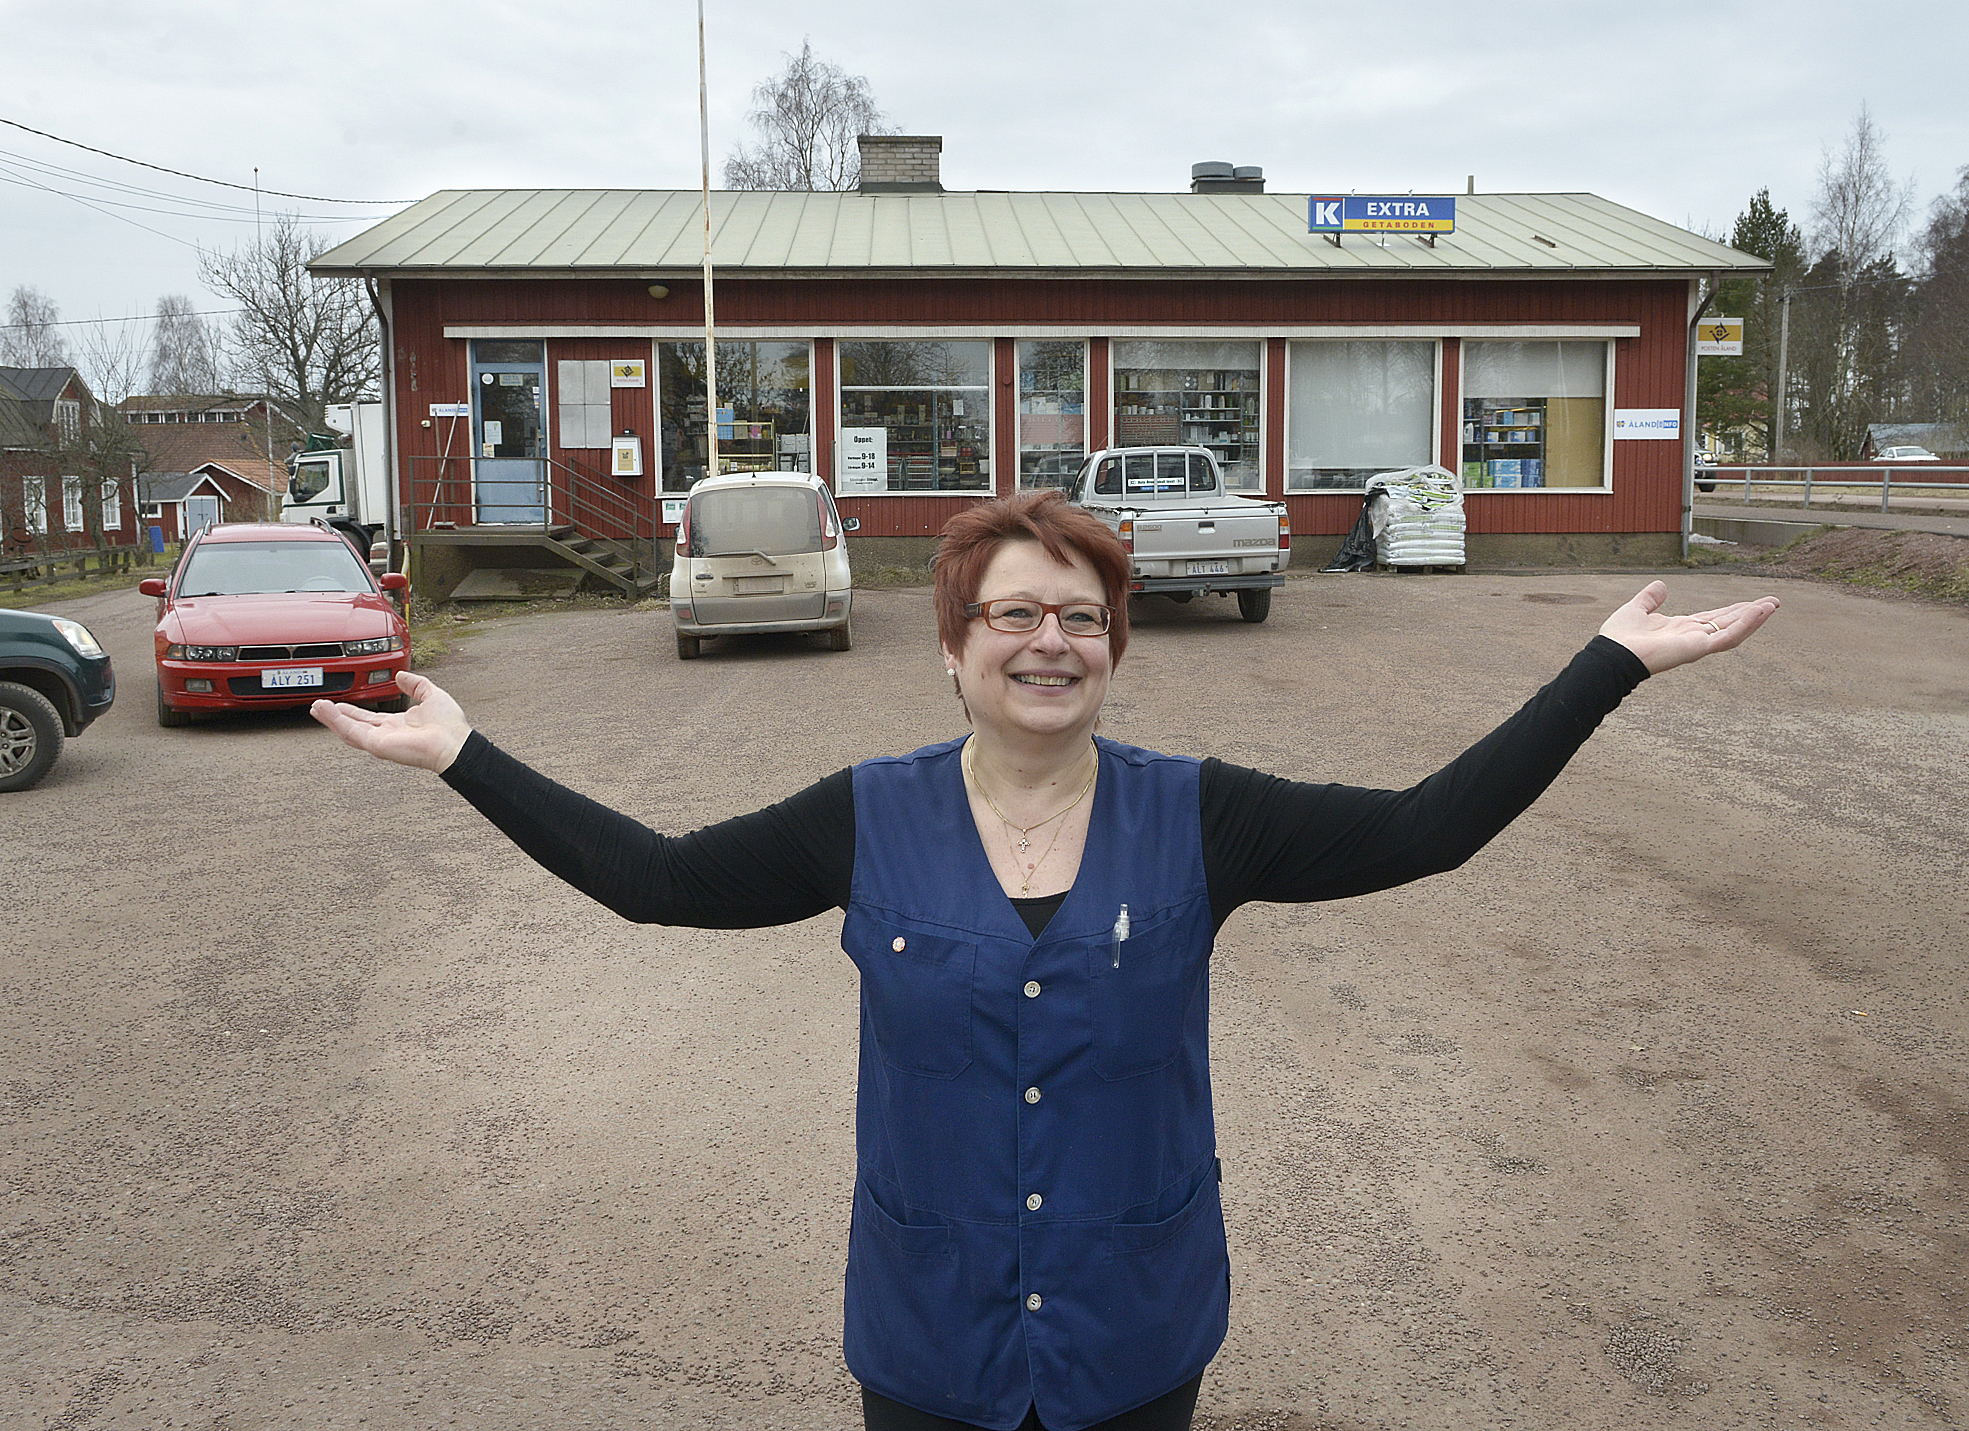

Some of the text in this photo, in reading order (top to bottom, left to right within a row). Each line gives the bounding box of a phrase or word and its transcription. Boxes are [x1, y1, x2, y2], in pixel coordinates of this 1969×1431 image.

[1315, 202, 1430, 225] K EXTRA
[1210, 564, 1224, 573] 446
[297, 675, 314, 684] 251
